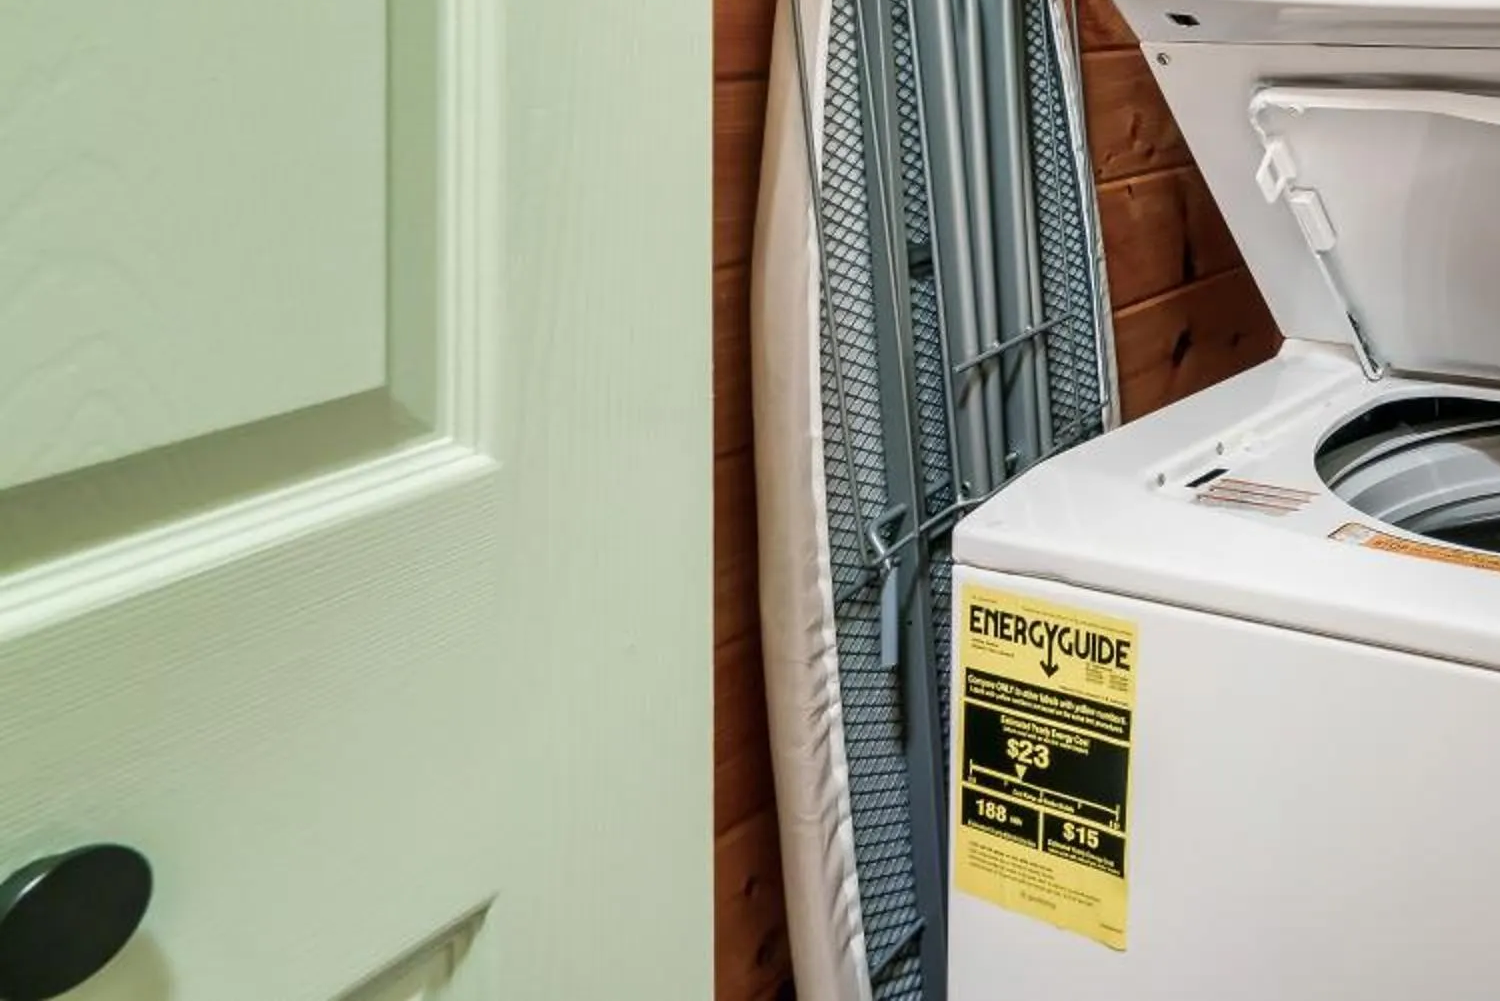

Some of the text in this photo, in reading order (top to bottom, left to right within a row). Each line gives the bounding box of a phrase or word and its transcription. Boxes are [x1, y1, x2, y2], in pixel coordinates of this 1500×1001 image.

[970, 605, 1131, 672] ENERGYGUIDE
[1006, 737, 1050, 769] $23
[976, 797, 1008, 823] 188
[1063, 821, 1100, 850] $15
